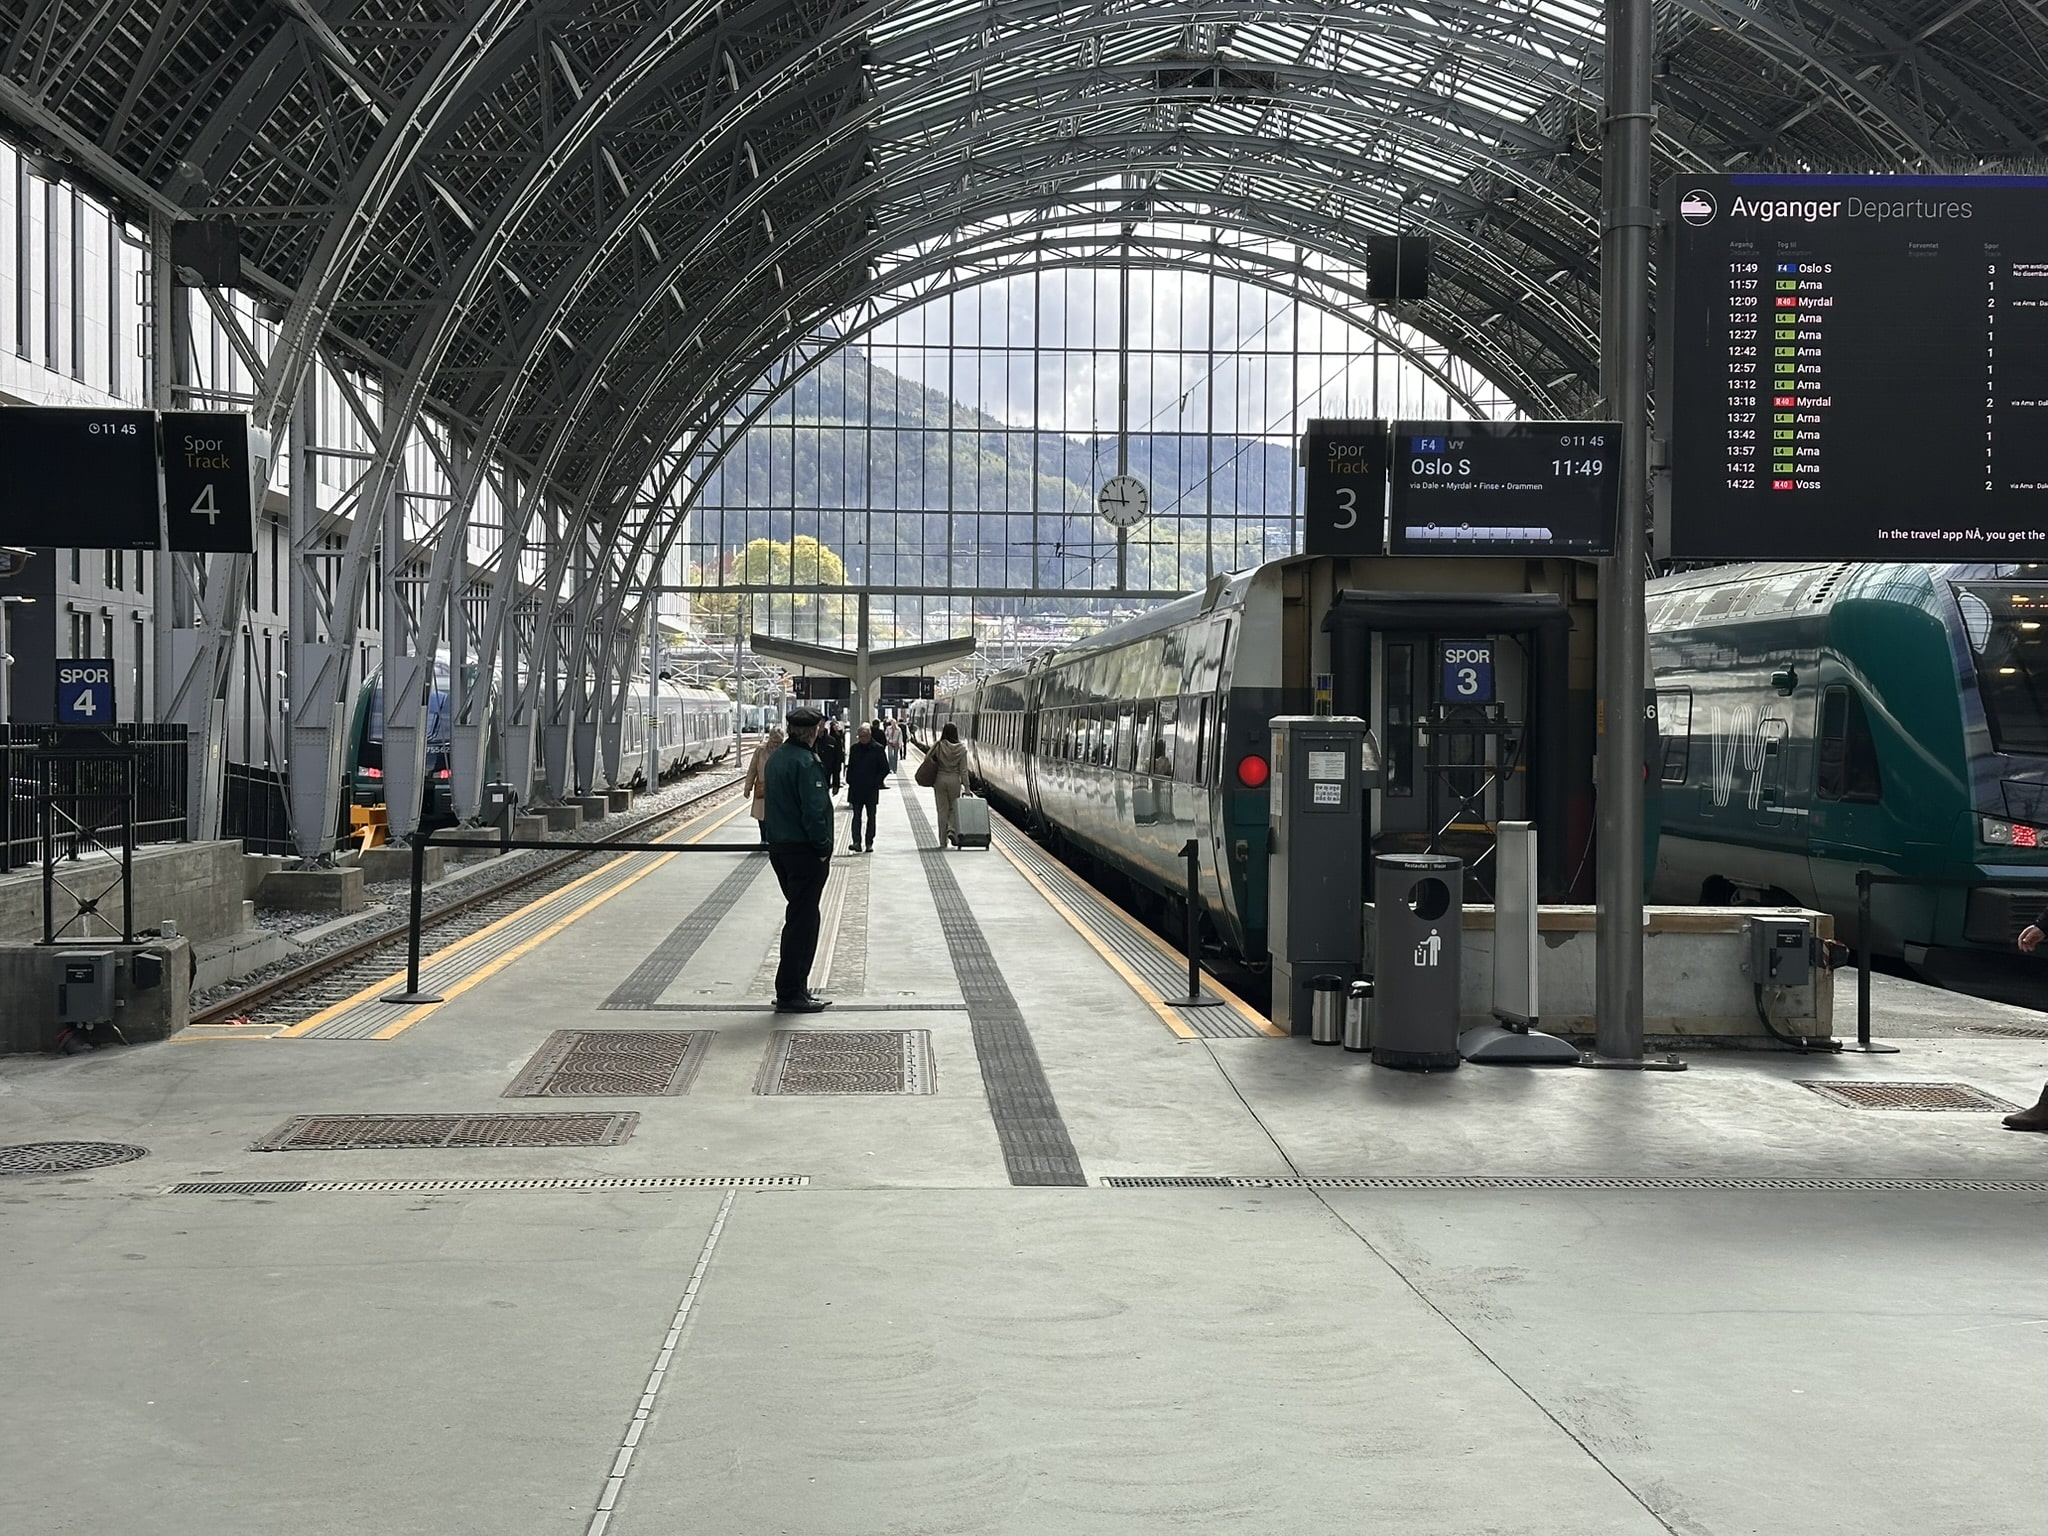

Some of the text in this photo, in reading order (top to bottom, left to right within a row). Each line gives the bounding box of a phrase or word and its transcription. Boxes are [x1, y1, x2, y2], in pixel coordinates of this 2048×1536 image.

[1731, 197, 1972, 222] Avganger Departures
[1777, 241, 1788, 249] Tog
[1984, 243, 1999, 251] Spor
[1730, 263, 1995, 274] 11:49 F4 Oslo S 3
[1730, 280, 1993, 290] 11:57 L4 Arna 1
[1730, 297, 1757, 306] 12:09
[1778, 298, 1791, 306] R40
[1799, 297, 1832, 308] Myrdal
[1988, 298, 1994, 307] 2
[1729, 313, 1993, 324] 12:12 L4 Arna 1
[1729, 330, 1992, 340] 12:27 L4 Arna 1
[1729, 347, 1992, 357] 12:42 L4 Arna 1
[1728, 364, 1992, 374] 12:57 L4 Arna 1
[1728, 380, 1992, 390] 13:12 L4 Arna 1
[1728, 397, 1755, 406] 13:18
[1776, 397, 1789, 405] R40
[1797, 397, 1831, 408] Myrdal
[1987, 398, 1993, 407] 2
[1728, 413, 1991, 424] 13:27 L4 Arna 1
[103, 424, 136, 434] 11 45
[1728, 430, 1991, 440] 13:42 L4 Arna 1
[185, 436, 222, 452] Spor
[1421, 439, 1436, 450] F4
[1573, 436, 1584, 446] 11
[1590, 436, 1603, 446] 45
[1329, 442, 1364, 459] Spor
[1727, 446, 1991, 457] 13:57 L4 Arna 1
[185, 453, 230, 468] Track
[1328, 458, 1368, 473] Track
[1412, 458, 1602, 475] Oslo S 11:49
[1727, 463, 1990, 473] 14:12 L4 Arna 1
[1447, 482, 1471, 491] Myrdal
[1727, 480, 1754, 488] 14:22
[1775, 480, 1788, 488] R40
[1796, 480, 1820, 489] Voss
[1986, 481, 1992, 490] 2
[191, 484, 220, 525] 4
[1334, 488, 1356, 529] 3
[1879, 528, 2045, 542] In the travel app NÅ, you get the
[1446, 650, 1489, 663] SPOR
[60, 669, 108, 683] SPOR
[1458, 668, 1477, 694] 3
[74, 689, 96, 715] 4
